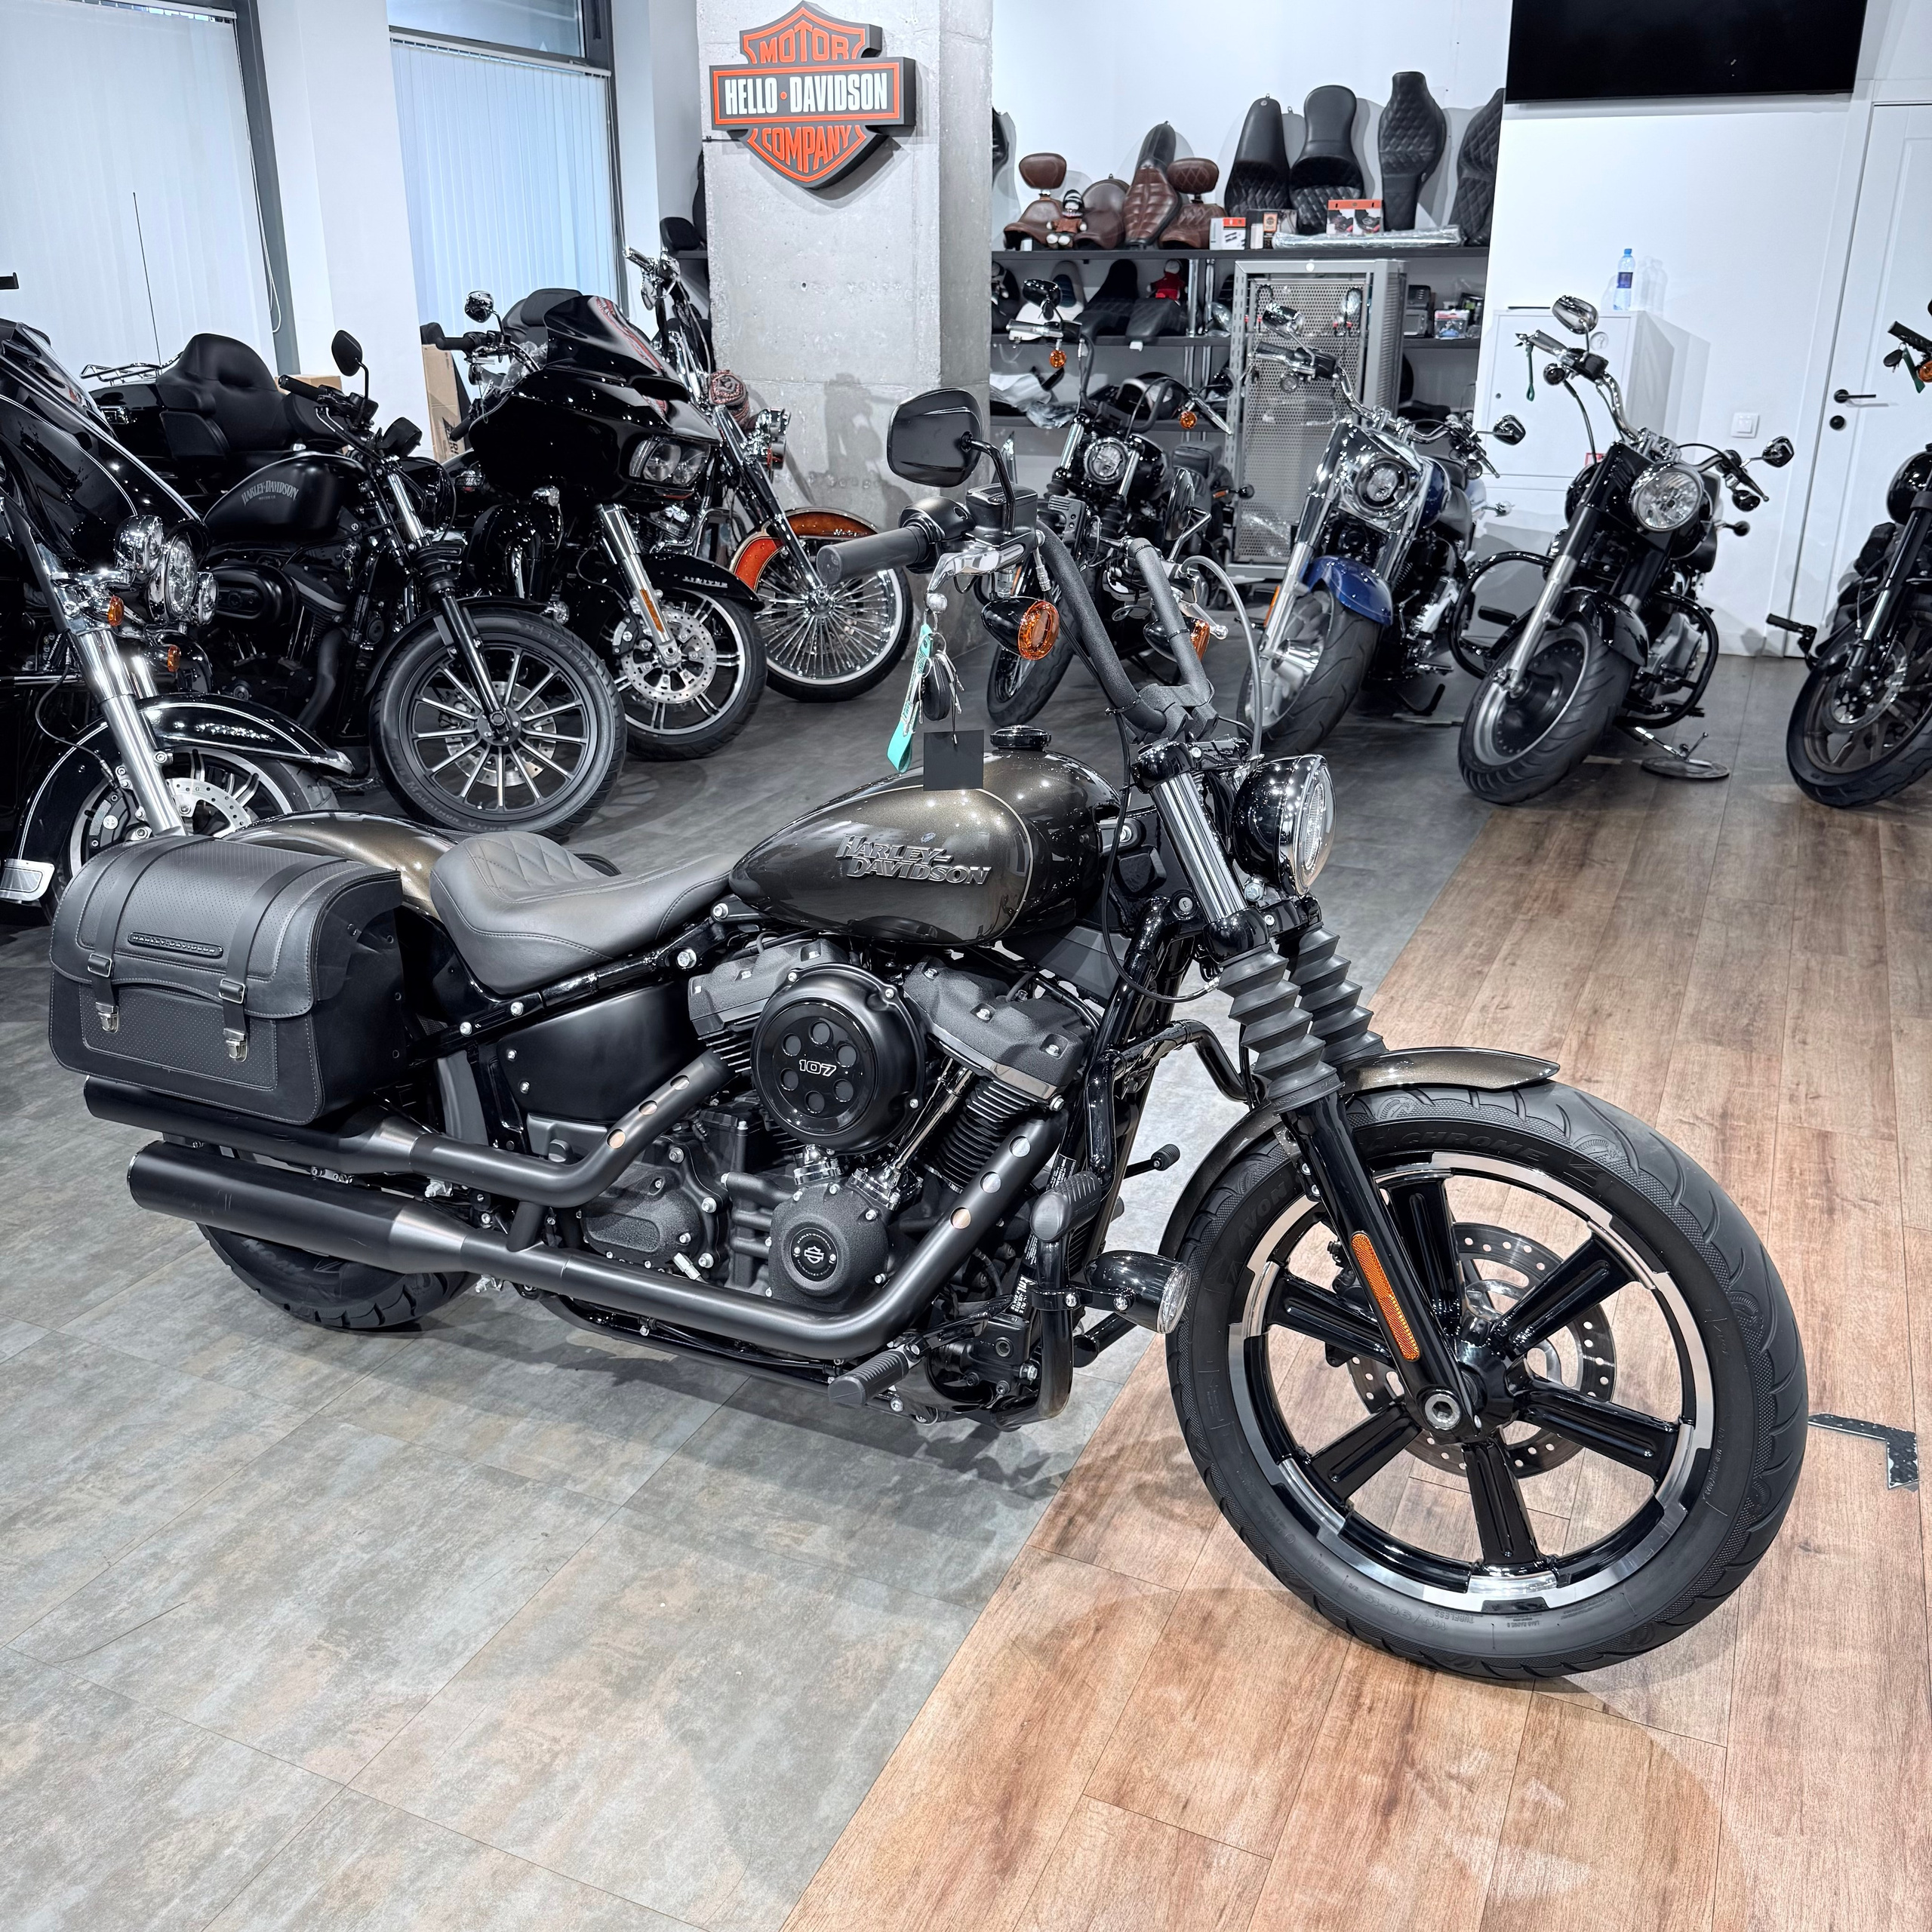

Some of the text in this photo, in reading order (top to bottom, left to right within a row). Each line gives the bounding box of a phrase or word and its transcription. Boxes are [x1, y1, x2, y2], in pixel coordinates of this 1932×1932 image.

[759, 20, 849, 63] MOTOR
[724, 72, 888, 115] HELLO DAVIDSON
[761, 125, 851, 174] COMPANY
[846, 857, 992, 884] DAVIDSON
[798, 1059, 837, 1077] 107
